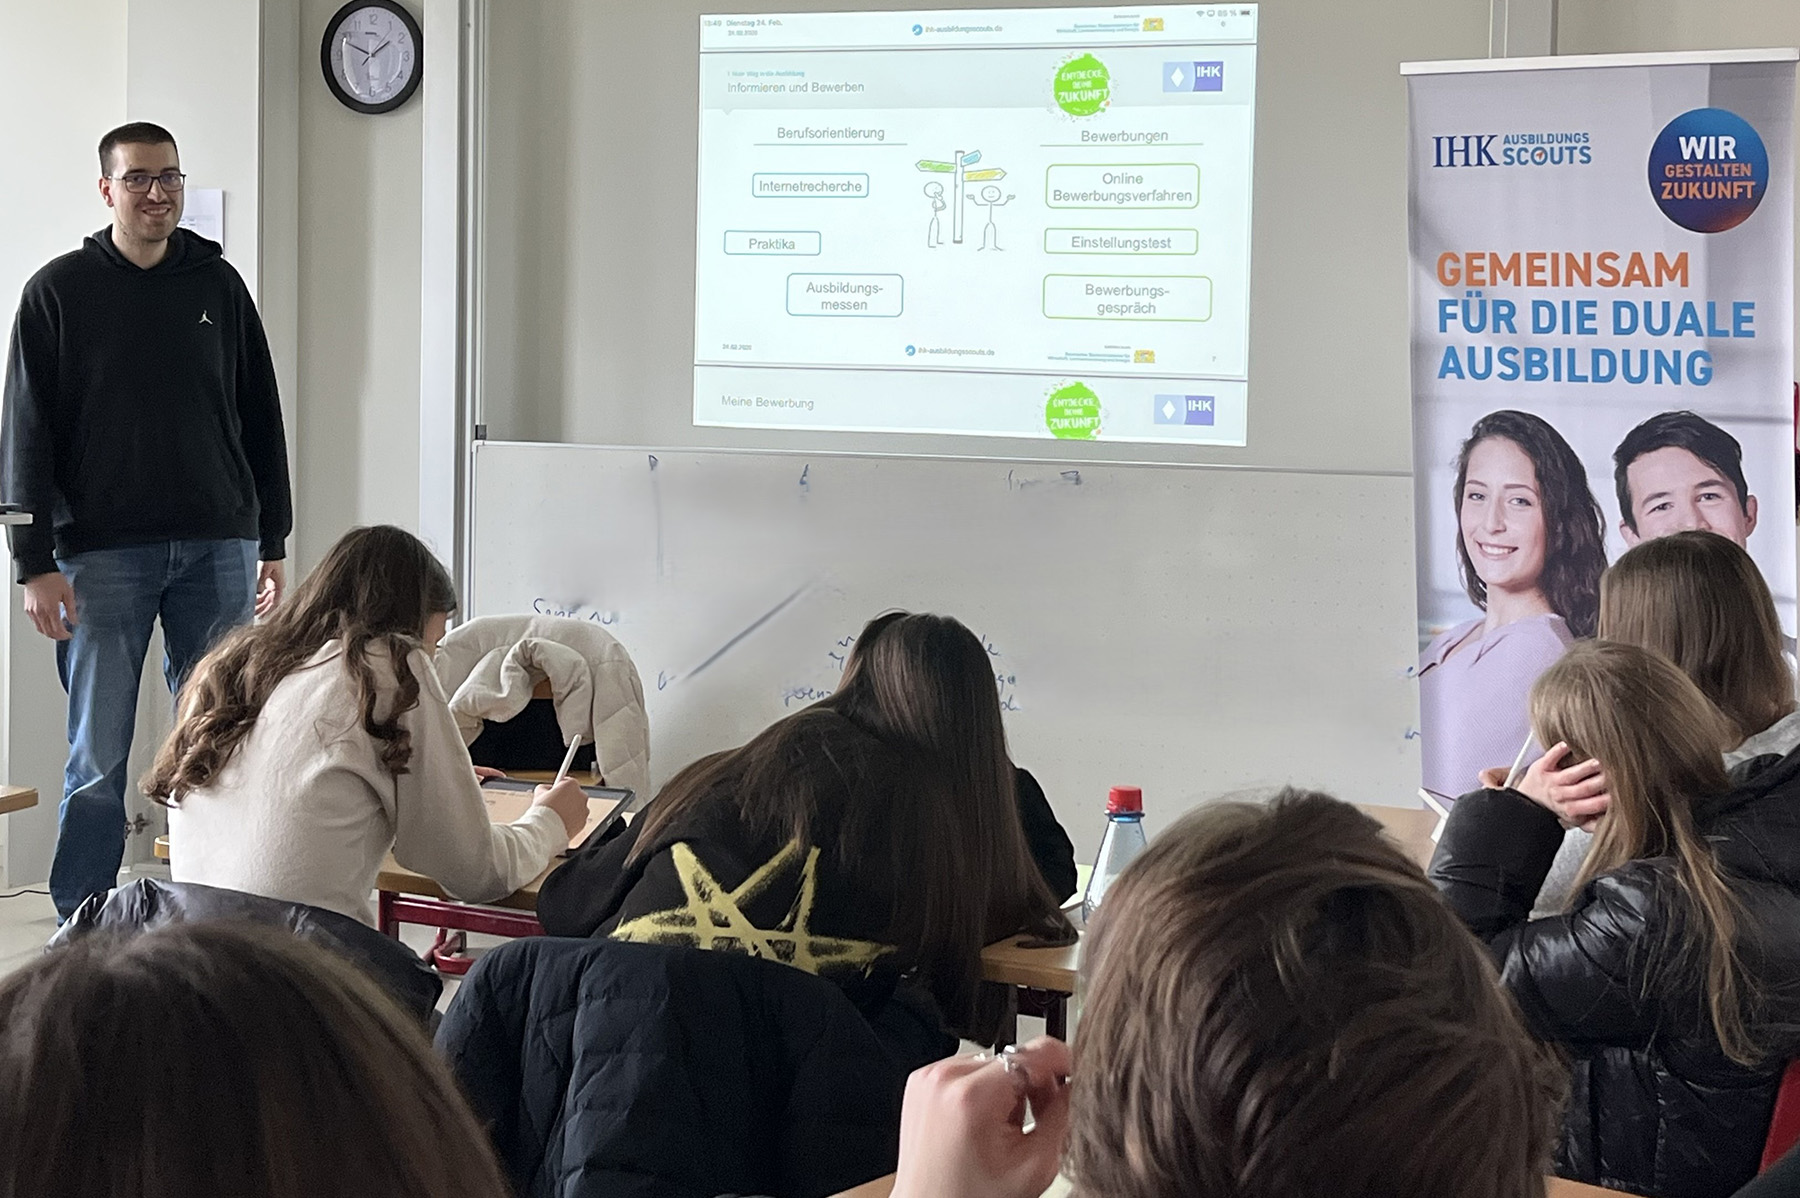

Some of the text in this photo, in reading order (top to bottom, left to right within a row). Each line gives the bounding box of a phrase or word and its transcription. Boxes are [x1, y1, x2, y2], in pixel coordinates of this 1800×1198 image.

[397, 32, 406, 45] 2
[1061, 69, 1103, 82] ENTDECKE
[1196, 66, 1221, 78] IHK
[728, 82, 864, 92] Informieren und Bewerben
[1058, 88, 1109, 104] ZUKUNFT
[777, 127, 885, 141] Berufsorientierung
[1081, 130, 1169, 144] Bewerbungen
[1502, 133, 1590, 146] AUSBILDUNGS
[1432, 135, 1500, 168] IHK
[1679, 136, 1736, 160] WIR
[1502, 146, 1592, 166] SCOUTS
[1664, 162, 1752, 178] GESTALTEN
[1102, 172, 1144, 185] Online
[759, 181, 862, 192] Internetrecherche
[1661, 181, 1756, 200] ZUKUNFT
[1053, 190, 1192, 203] Bewerbungsverfahren
[748, 238, 796, 250] Praktika
[1071, 236, 1172, 251] Einstellungstest
[1436, 252, 1689, 288] GEMEINSAM
[806, 282, 884, 296] Ausbildungs-
[1085, 284, 1170, 298] Bewerbungs-
[820, 300, 868, 310] messen
[1096, 301, 1156, 316] gespräch
[1438, 290, 1756, 338] FÜR DIE DUALE
[1438, 346, 1713, 386] AUSBILDUNG
[721, 396, 814, 410] Meine Bewerbung
[1188, 400, 1212, 412] IHK
[1050, 416, 1100, 430] ZUKUNFT
